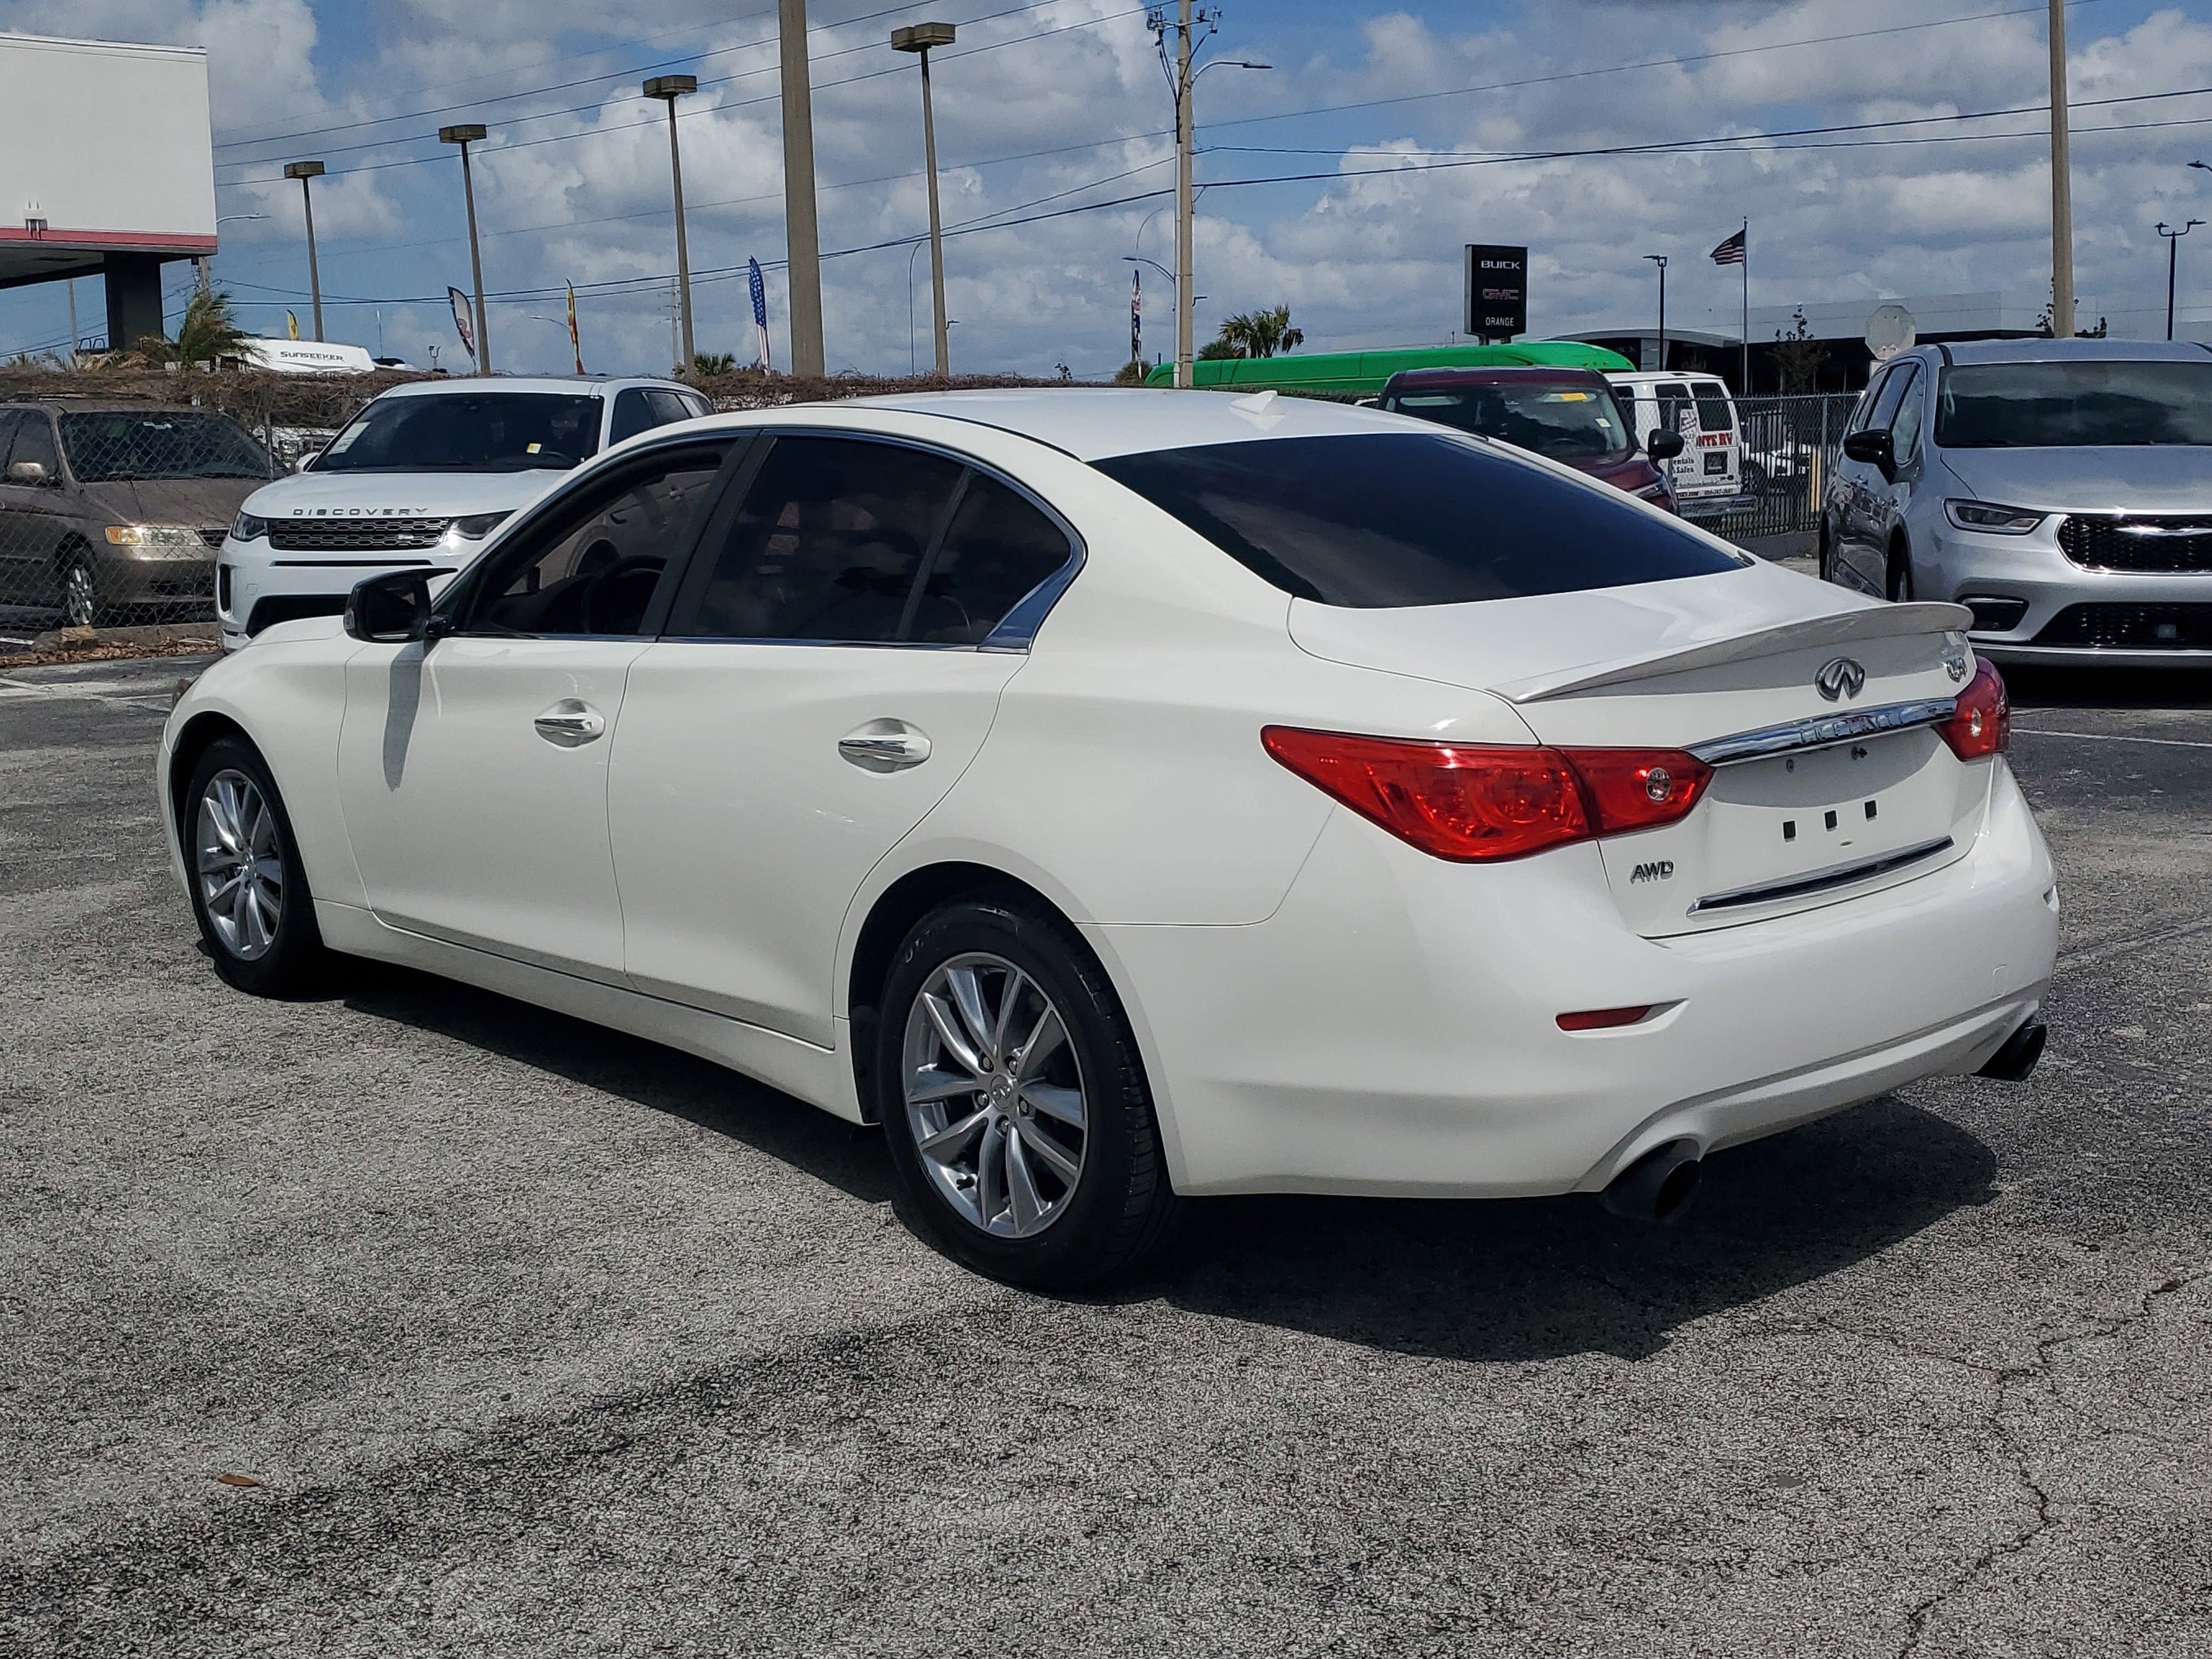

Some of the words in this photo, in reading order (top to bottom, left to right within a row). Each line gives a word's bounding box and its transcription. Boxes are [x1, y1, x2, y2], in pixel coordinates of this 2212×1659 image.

[1481, 260, 1520, 269] BUICK
[1482, 288, 1519, 300] GMC
[1486, 317, 1514, 326] ORANGE
[1718, 432, 1733, 445] RV
[292, 507, 428, 516] DISCOVERY
[1630, 860, 1674, 884] AWD
